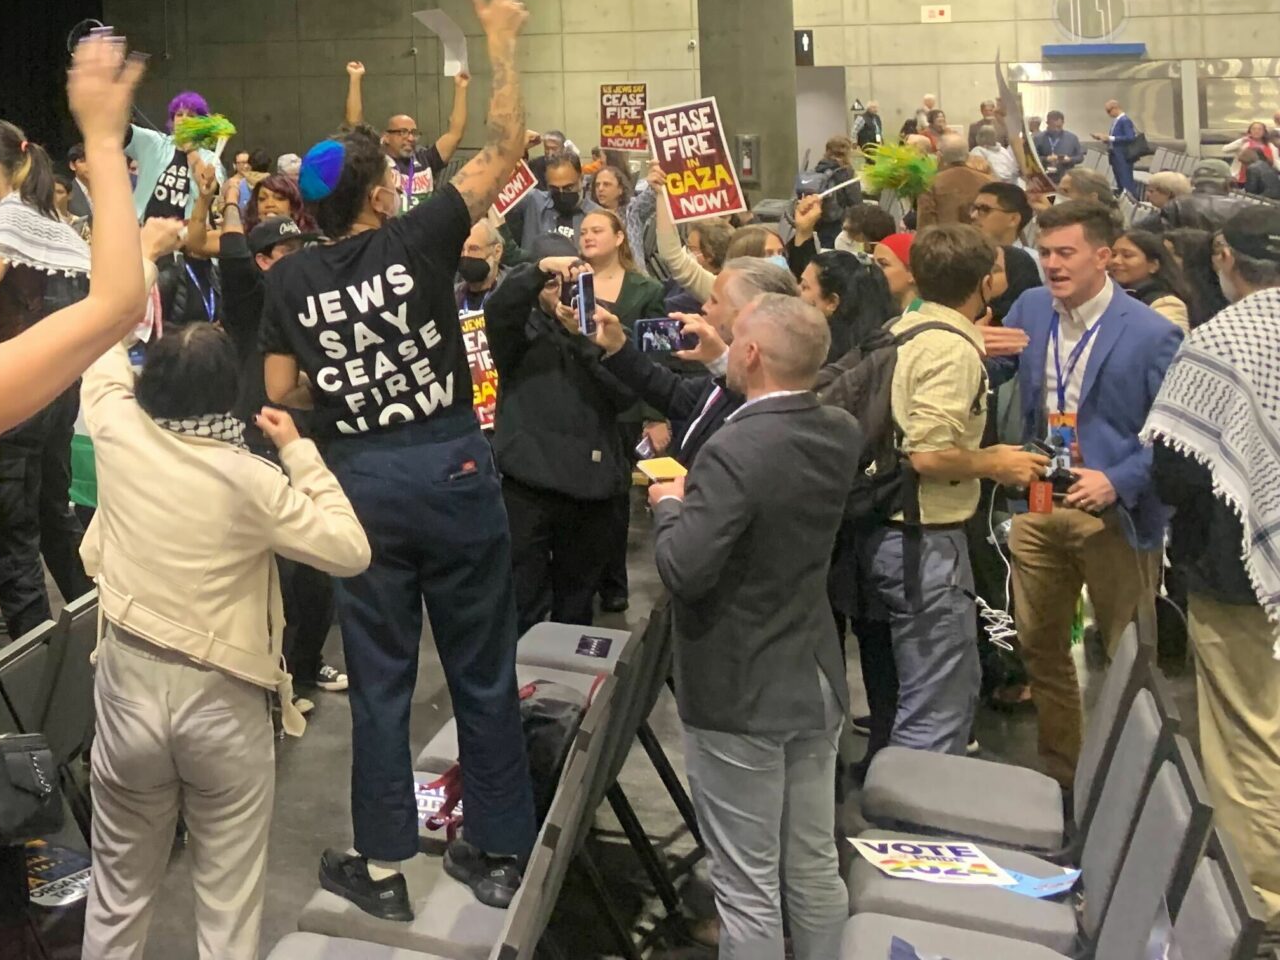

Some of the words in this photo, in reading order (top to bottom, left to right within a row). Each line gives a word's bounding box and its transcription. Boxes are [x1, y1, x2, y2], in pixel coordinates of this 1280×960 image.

[602, 94, 644, 106] CEASE
[606, 107, 641, 119] FIRE
[602, 124, 645, 137] GAZA
[653, 107, 715, 138] CEASE
[607, 138, 640, 148] NOW!
[663, 132, 716, 161] FIRE
[686, 157, 700, 168] IN
[498, 172, 527, 207] NOW!
[666, 164, 733, 195] GAZA
[680, 190, 730, 215] NOW!
[298, 264, 414, 327] JEWS
[319, 302, 410, 359] SAY
[317, 320, 441, 392] CEASE
[345, 357, 436, 414] FIRE
[486, 369, 498, 379] IN
[336, 372, 453, 434] NOW
[861, 841, 979, 858] VOTE
[880, 859, 998, 877] 2024
